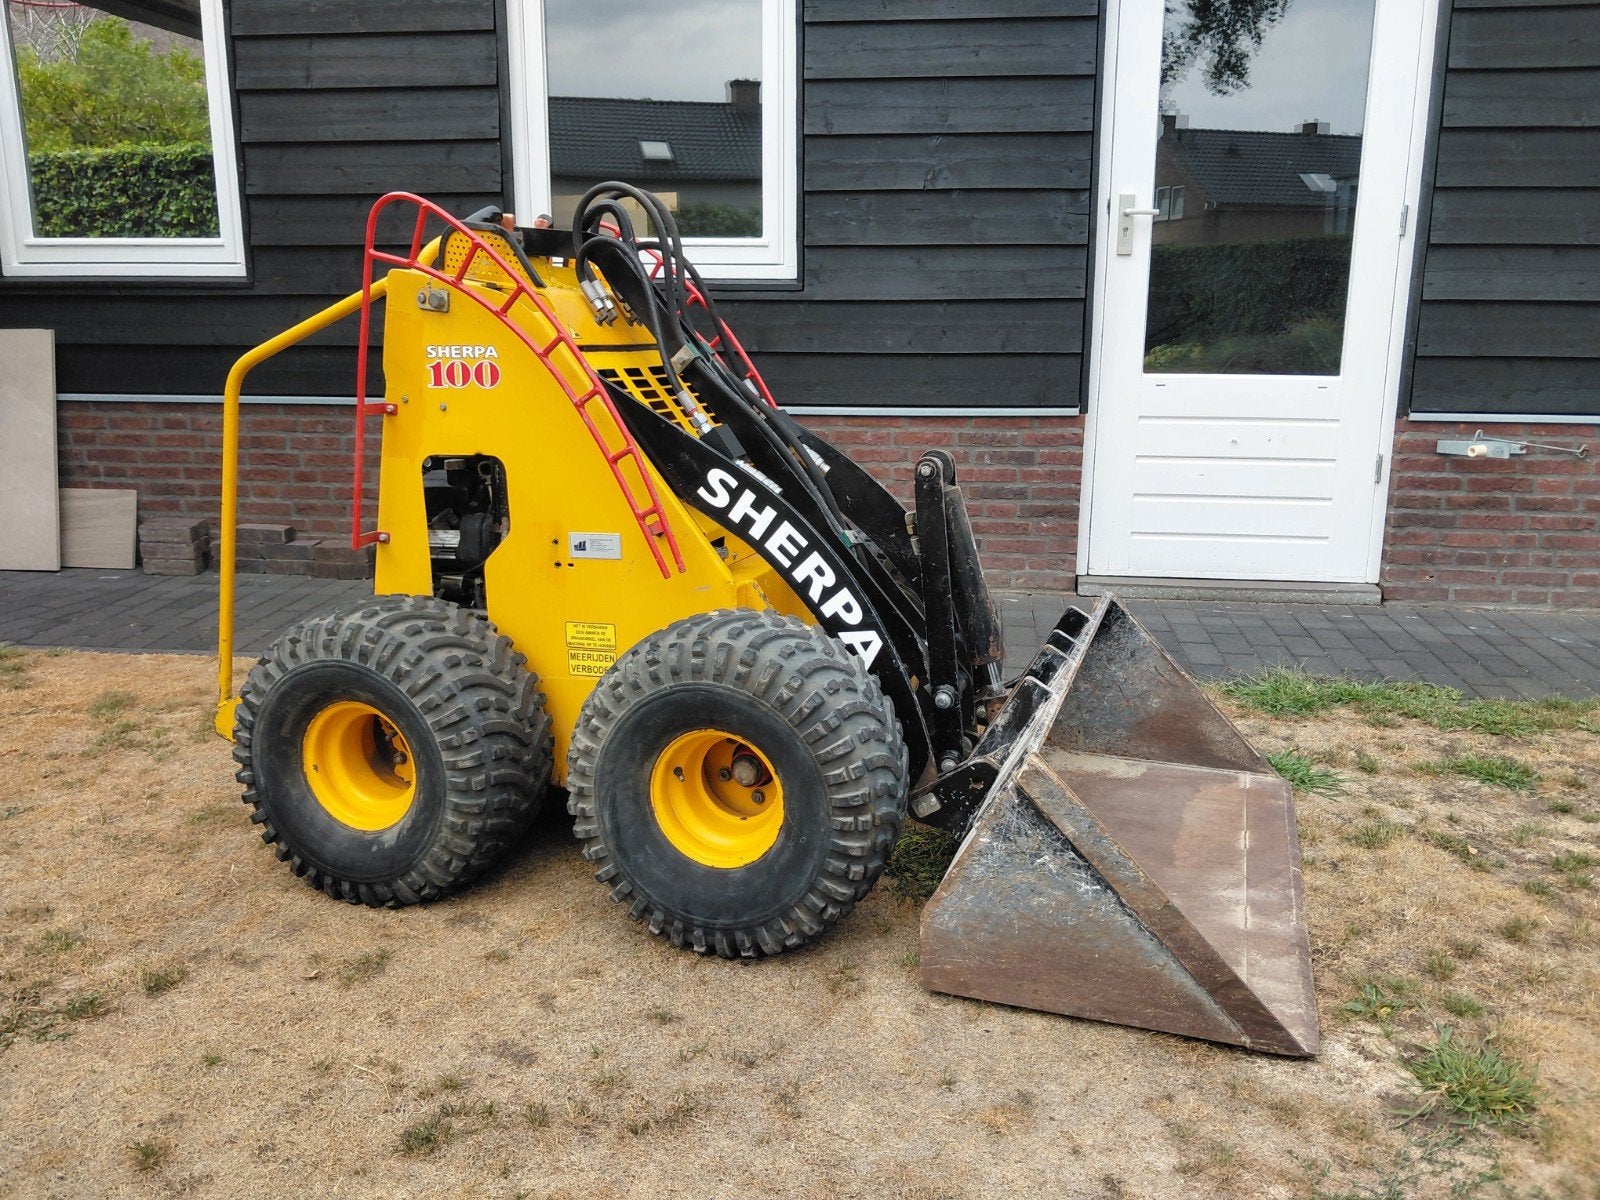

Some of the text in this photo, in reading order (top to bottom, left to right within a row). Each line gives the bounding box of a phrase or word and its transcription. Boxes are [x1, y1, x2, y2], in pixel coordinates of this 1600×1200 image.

[426, 345, 499, 358] SHERPA
[426, 359, 501, 389] 100
[697, 468, 883, 671] SHERPA
[570, 652, 615, 663] MEERIJDEN
[571, 664, 609, 675] VERBODE
